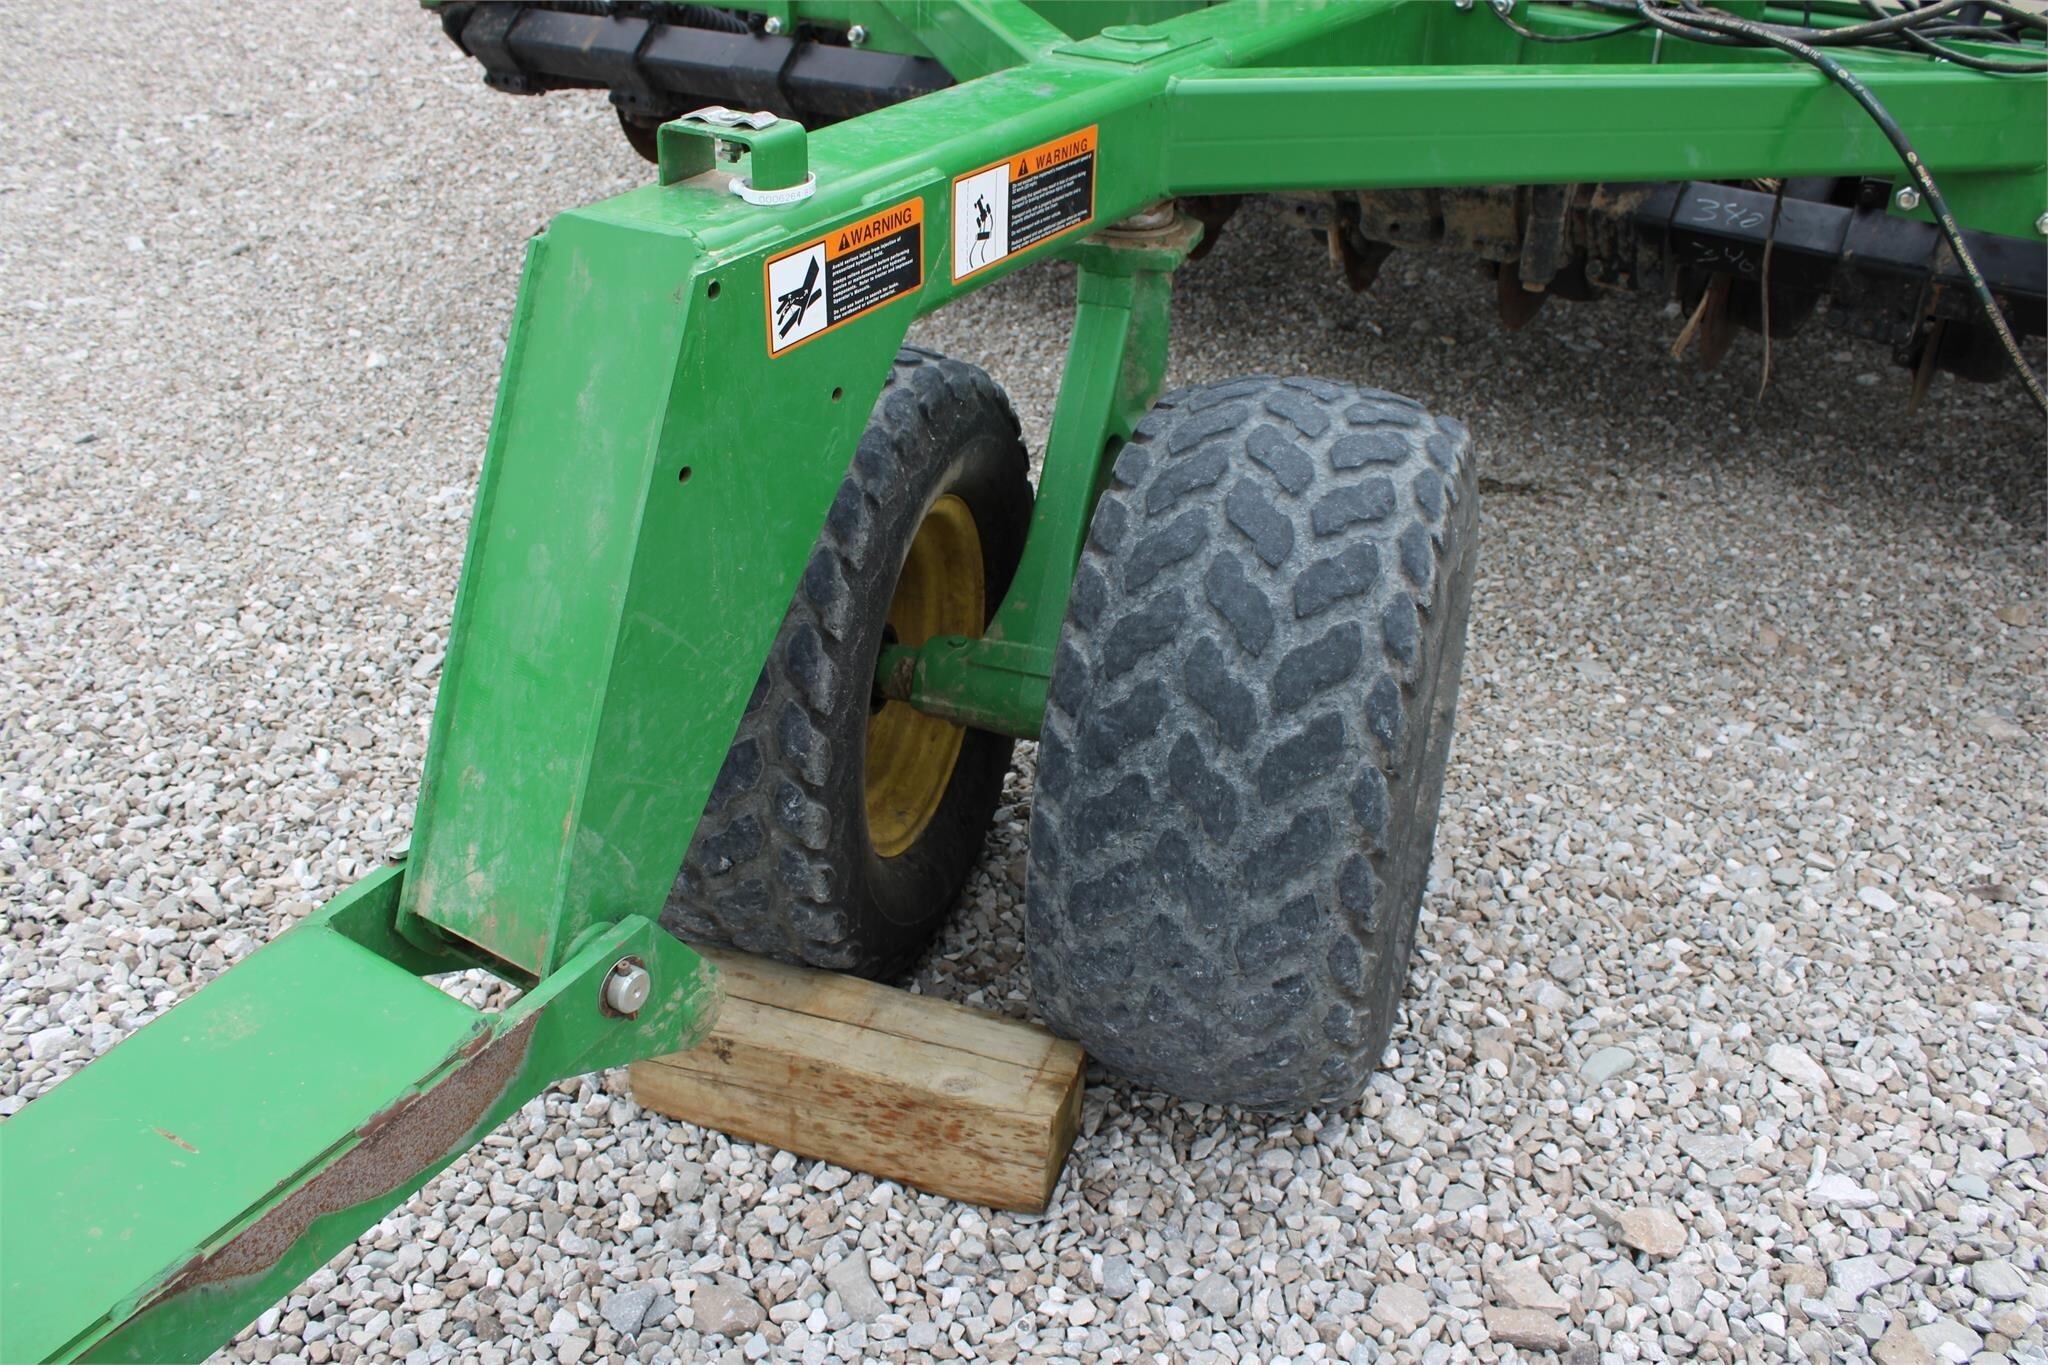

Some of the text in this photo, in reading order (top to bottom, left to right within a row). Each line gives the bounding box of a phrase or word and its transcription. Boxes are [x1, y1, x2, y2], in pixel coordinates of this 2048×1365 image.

[1036, 139, 1088, 169] WARNING
[851, 208, 912, 245] WARNING
[1693, 198, 1765, 229] 340
